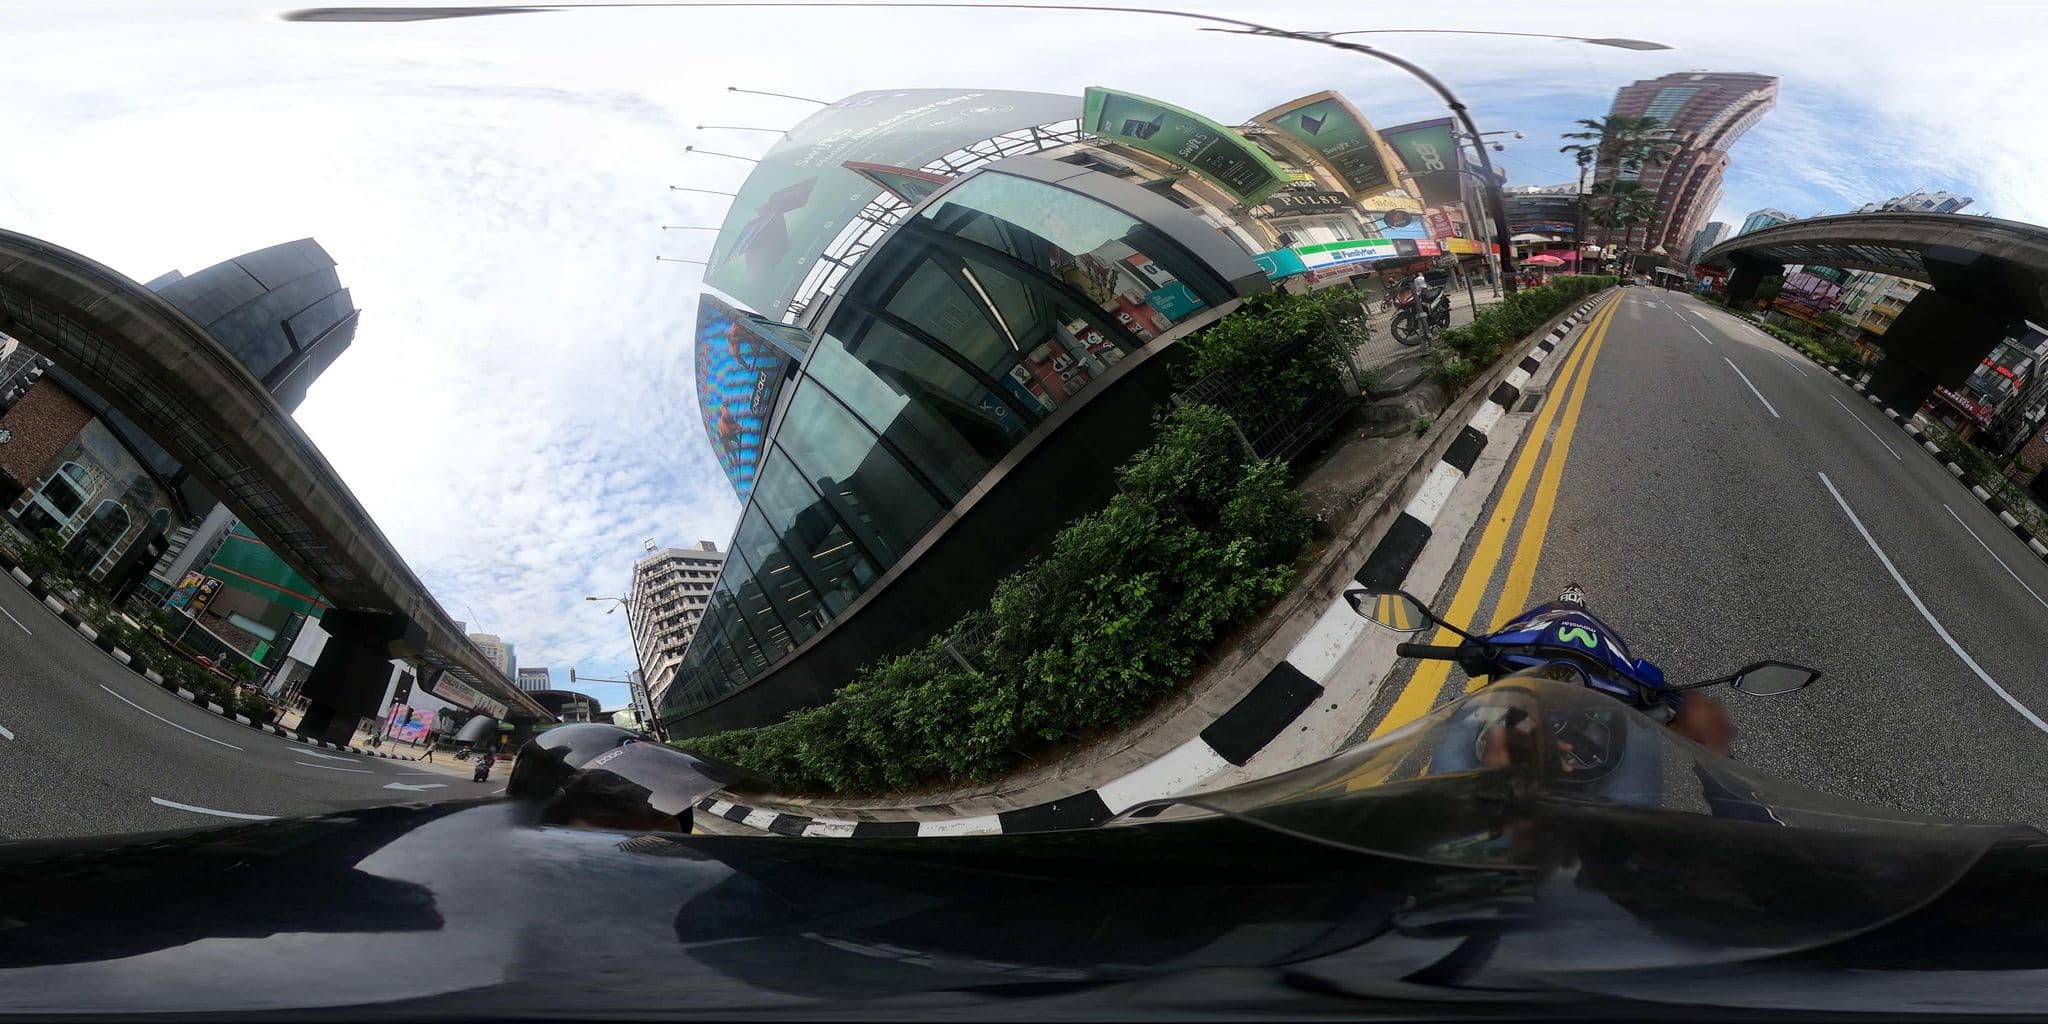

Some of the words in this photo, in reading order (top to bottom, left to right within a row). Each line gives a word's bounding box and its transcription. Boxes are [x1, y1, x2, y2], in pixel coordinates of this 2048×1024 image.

[1178, 138, 1202, 158] Swift
[1322, 141, 1351, 155] Swift
[1281, 194, 1343, 207] PULSE
[1341, 248, 1377, 259] FamilyMart
[1562, 622, 1596, 633] movistar
